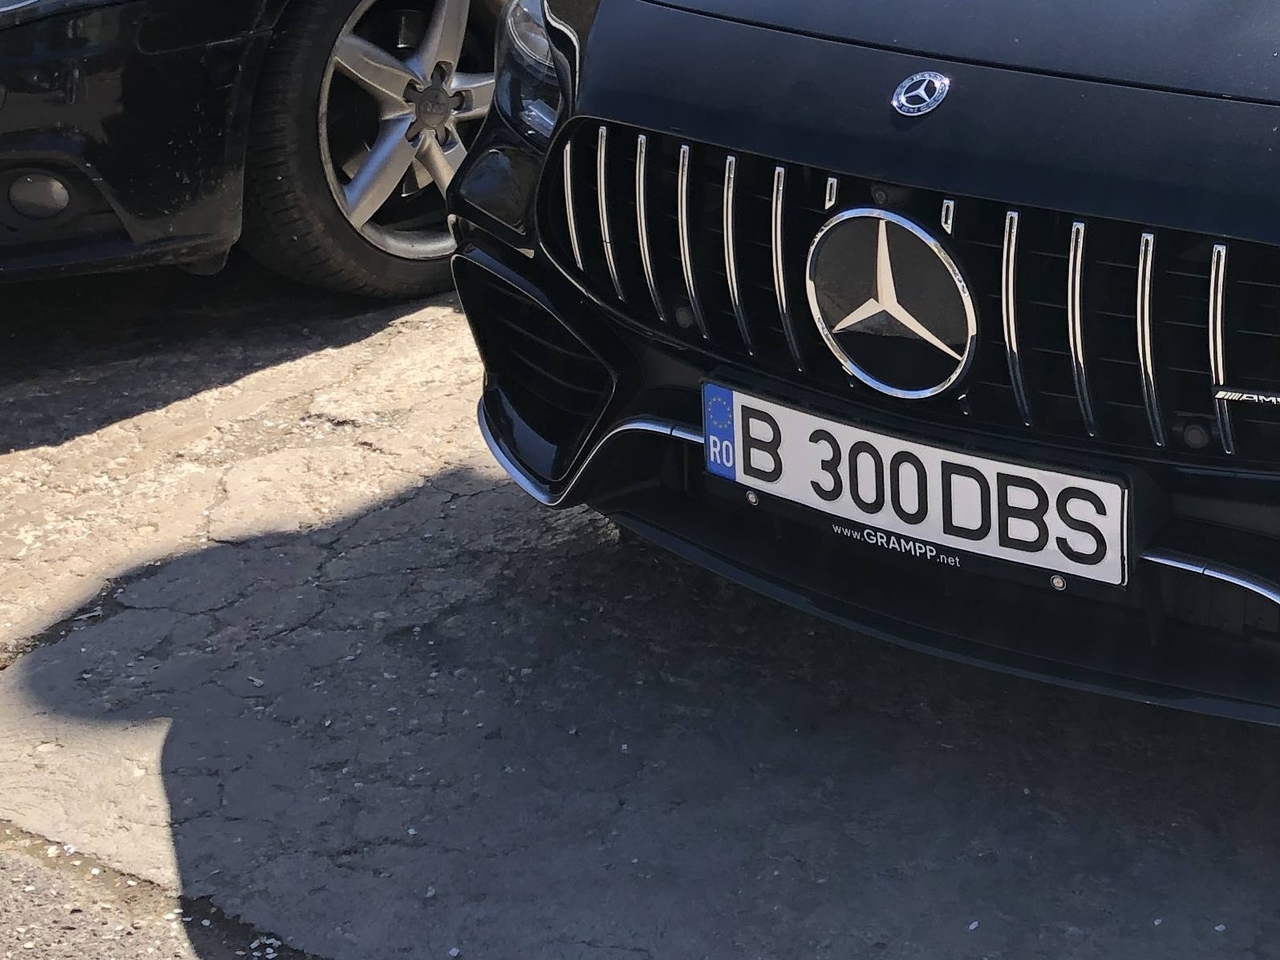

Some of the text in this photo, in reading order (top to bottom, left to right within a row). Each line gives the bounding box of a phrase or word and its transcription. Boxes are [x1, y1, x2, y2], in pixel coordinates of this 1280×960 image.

[709, 435, 733, 468] RO
[740, 404, 783, 483] B
[832, 524, 961, 567] www.GRAMPP.net
